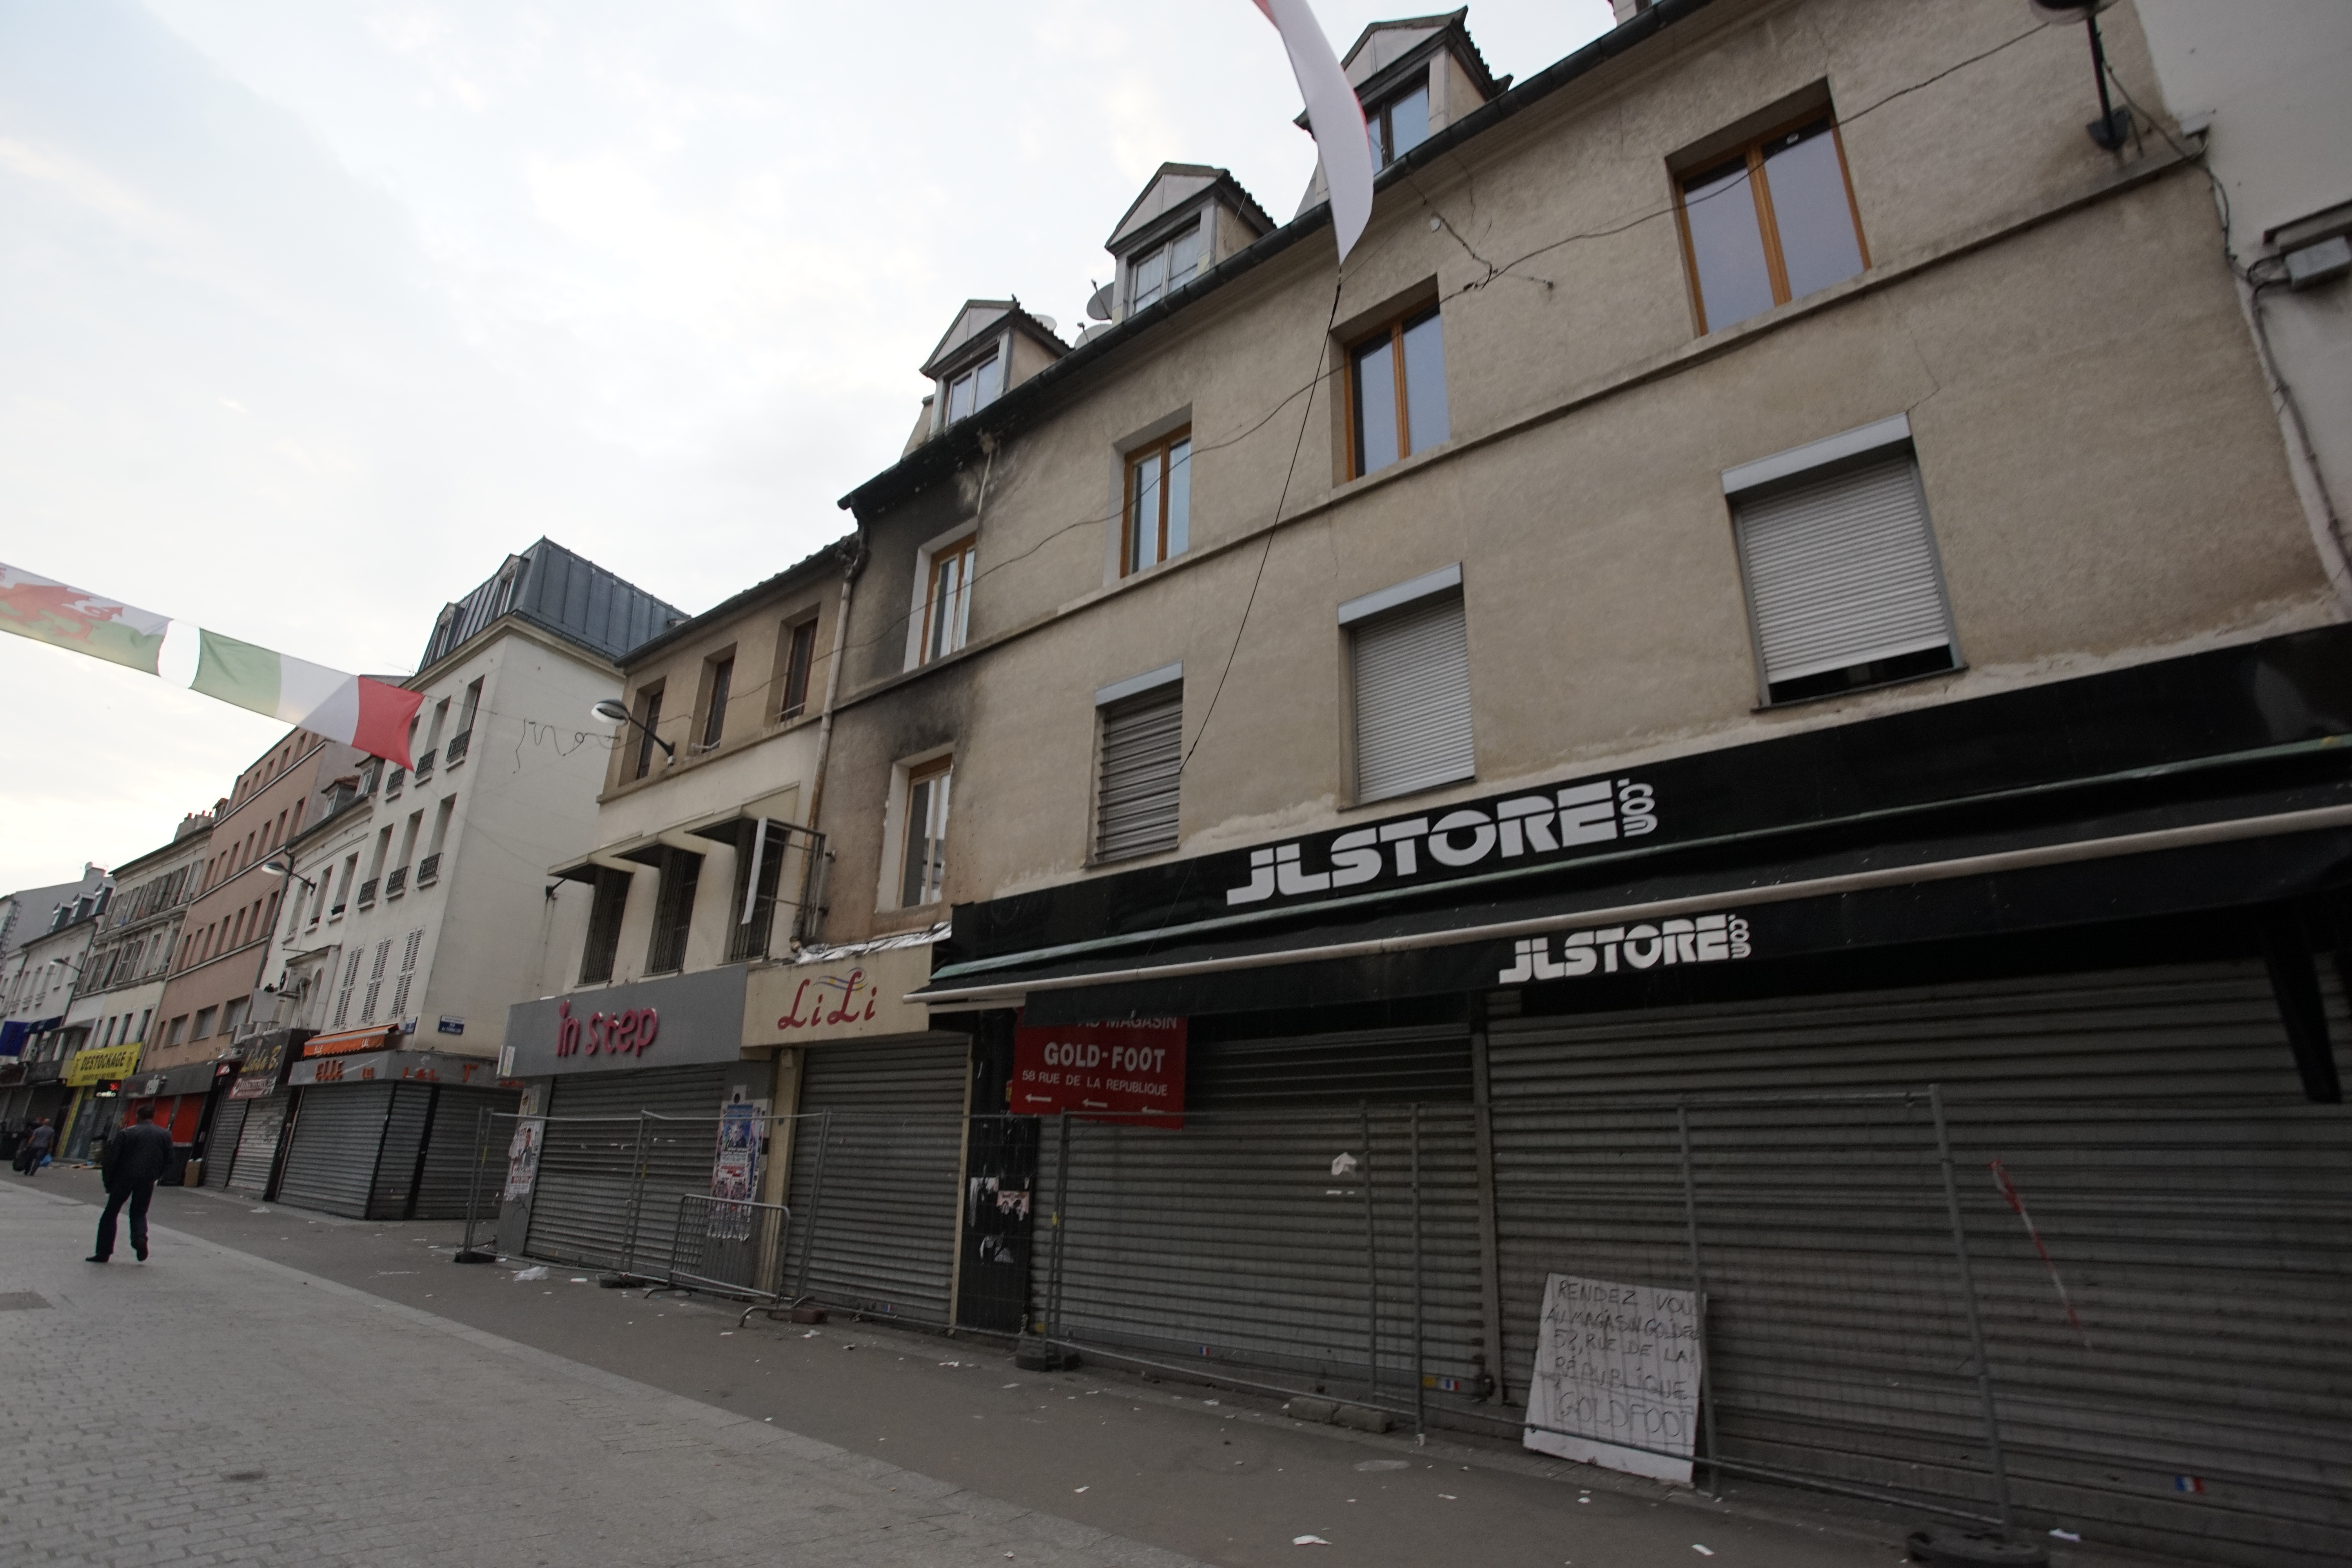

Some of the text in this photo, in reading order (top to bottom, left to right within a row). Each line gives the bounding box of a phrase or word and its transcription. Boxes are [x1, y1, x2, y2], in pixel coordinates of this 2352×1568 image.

[80, 1051, 127, 1071] DESTOCKAGE
[1044, 1041, 1166, 1074] GOLD-FOOT
[1022, 1070, 1169, 1096] 58 RUE DE LA REPUBLIQUE
[1557, 1279, 1697, 1316] RENDEZ VOU
[1585, 1334, 1617, 1352] RUE
[1622, 1339, 1653, 1357] DE
